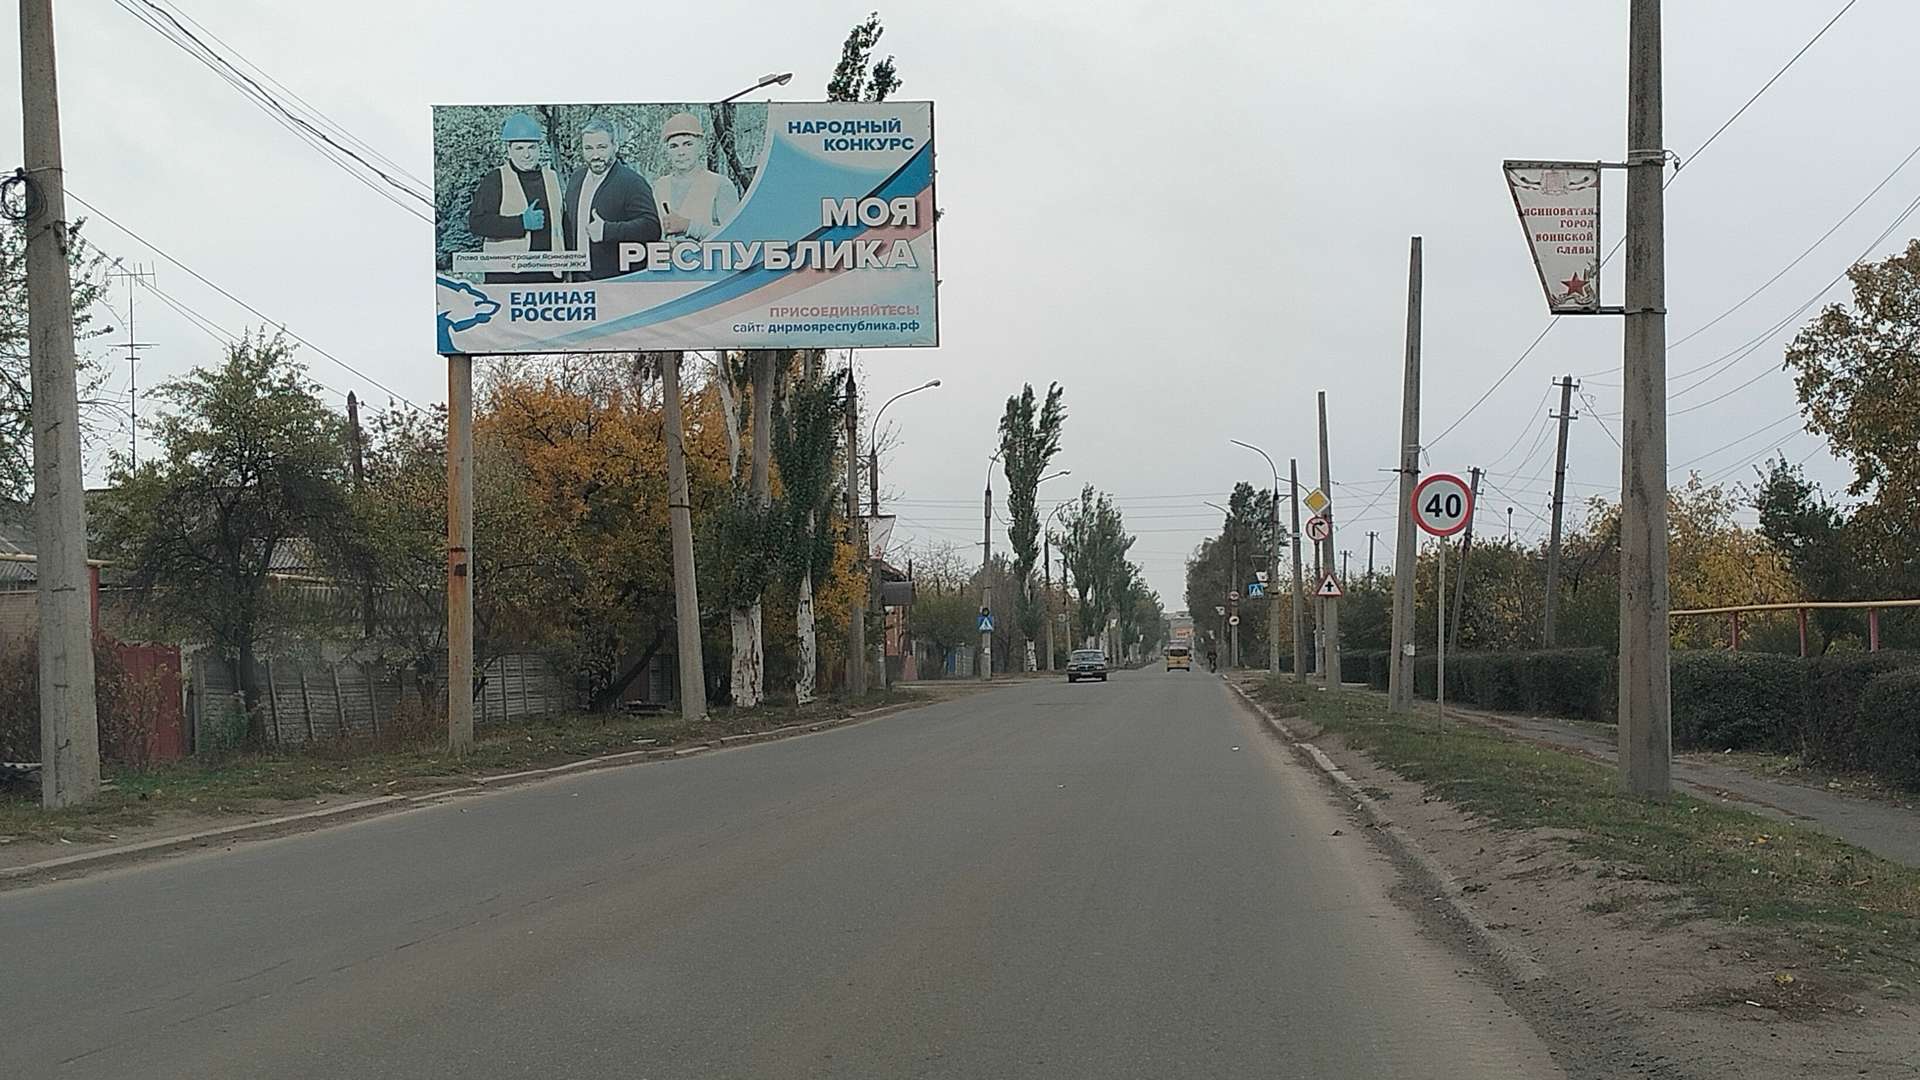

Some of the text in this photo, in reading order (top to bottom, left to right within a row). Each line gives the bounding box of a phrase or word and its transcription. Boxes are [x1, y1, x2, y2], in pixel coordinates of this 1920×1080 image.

[788, 119, 901, 134] НАРОДНЫЙ
[824, 138, 914, 151] КОНКУРС
[821, 197, 917, 227] МОЯ
[1560, 219, 1594, 228] ГОРОД
[1536, 232, 1593, 241] ВОИНСКОЙ
[618, 240, 917, 271] РЕСПУБЛИКА
[1557, 246, 1594, 254] СЛАВЫ
[510, 291, 596, 306] ЕДИНАЯ
[510, 307, 597, 321] РОССИЯ
[770, 305, 919, 318] ПРИСОЕДИНЯЙТЕСЬ!
[733, 319, 920, 333] сайт: днрмояреспублика.рф
[1425, 494, 1462, 518] 40
